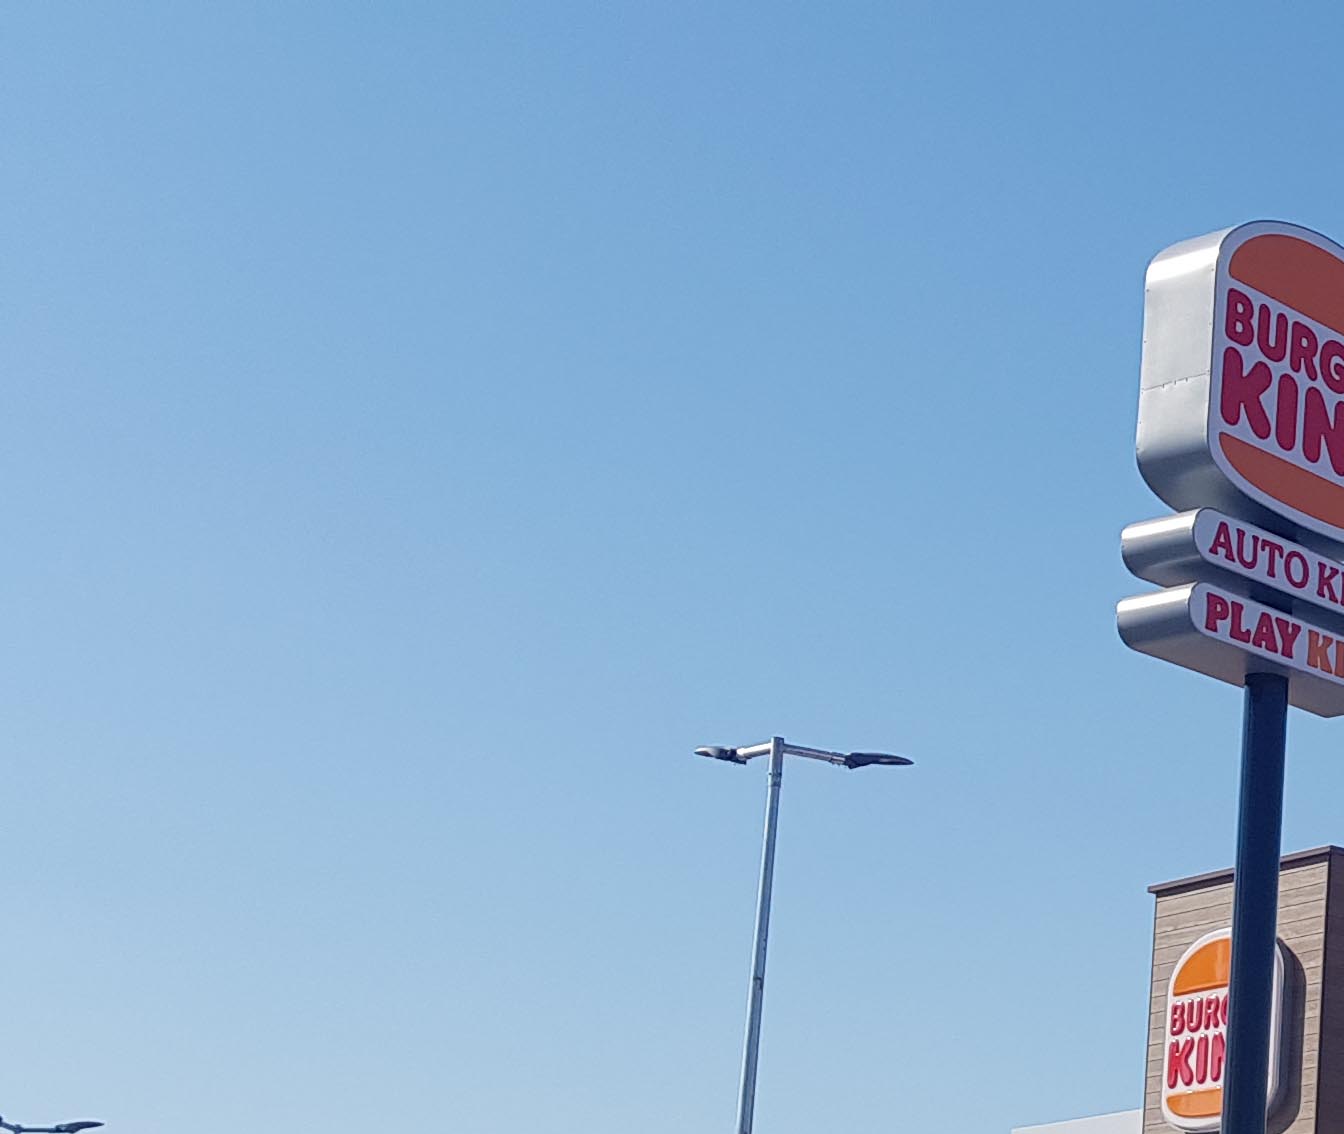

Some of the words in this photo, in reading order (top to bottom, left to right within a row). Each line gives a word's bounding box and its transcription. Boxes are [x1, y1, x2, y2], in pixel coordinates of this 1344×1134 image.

[1209, 521, 1310, 589] AUTO
[1204, 592, 1302, 659] PLAY
[1170, 992, 1229, 1036] BUR
[1166, 1031, 1226, 1089] KIN
